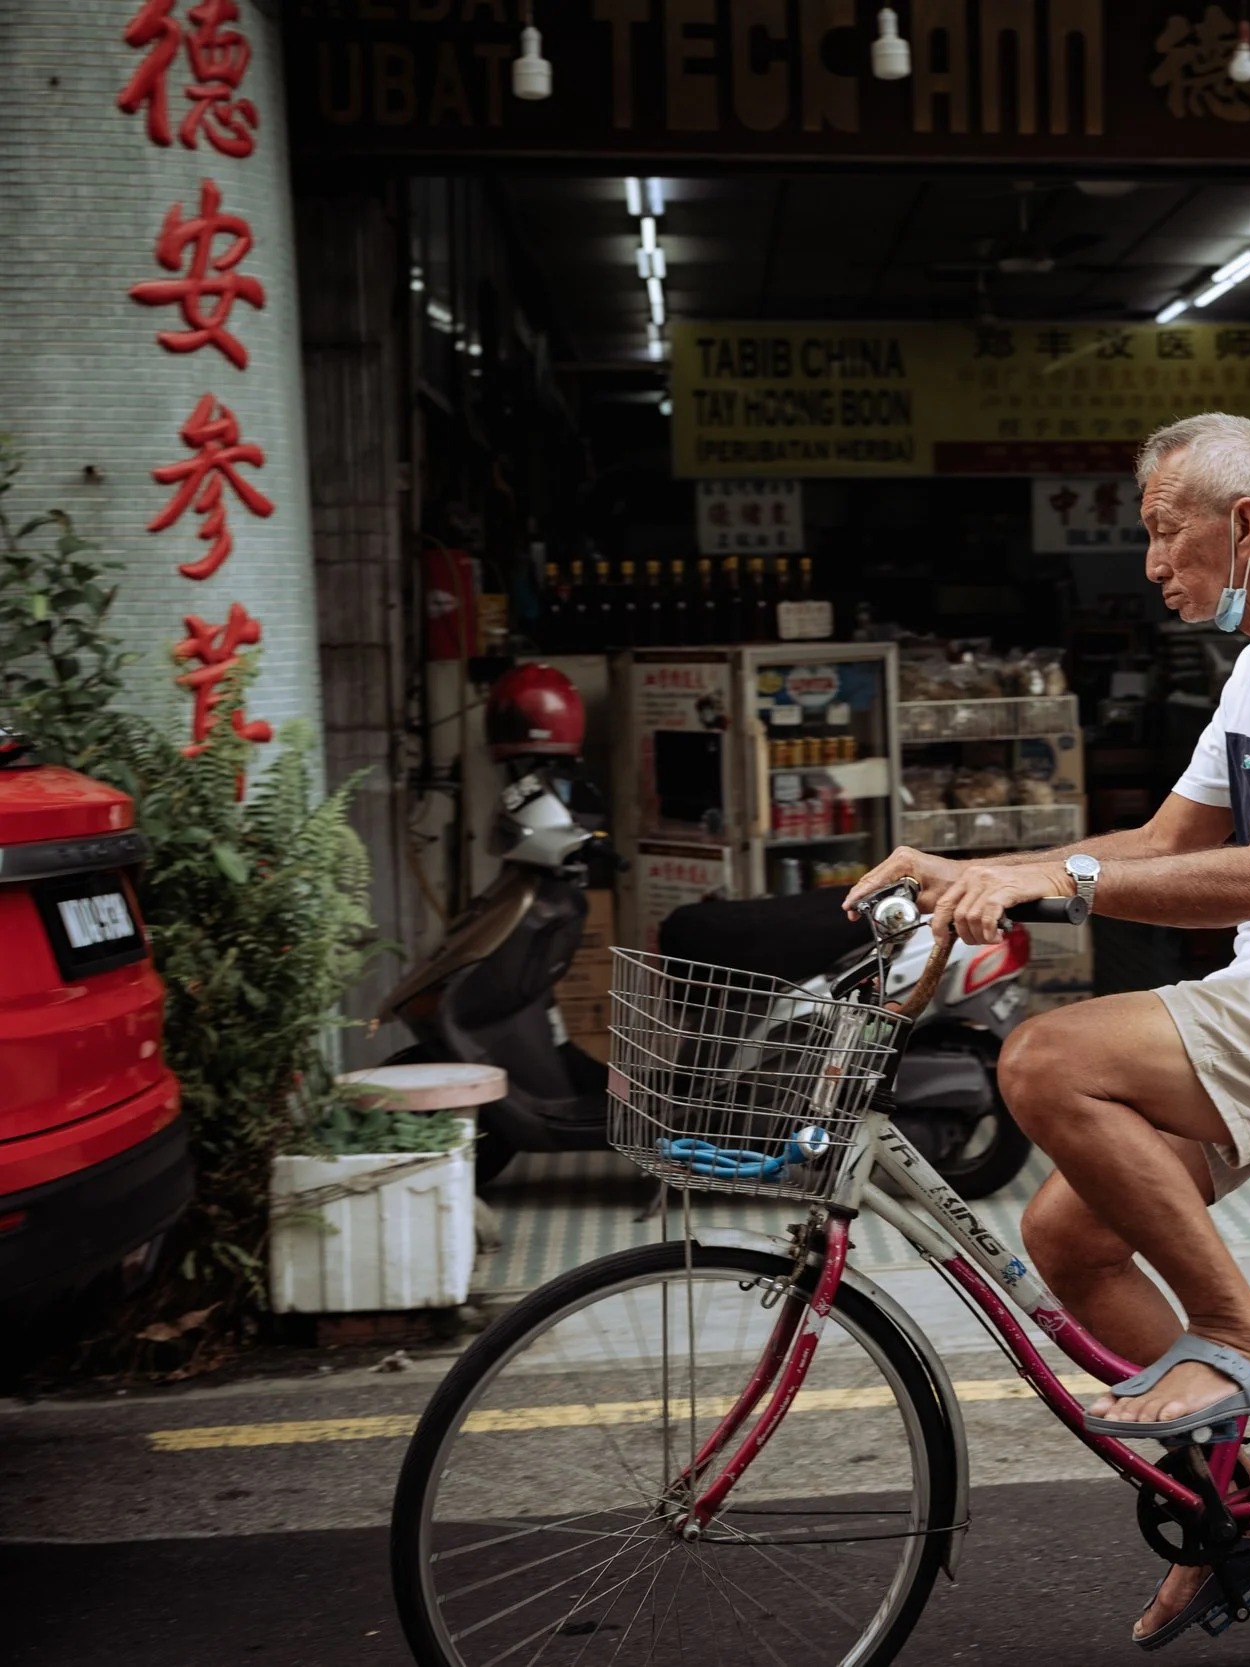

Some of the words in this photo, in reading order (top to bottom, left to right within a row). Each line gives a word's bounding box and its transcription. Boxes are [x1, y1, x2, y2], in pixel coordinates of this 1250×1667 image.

[316, 39, 514, 128] UBAT
[697, 338, 793, 378] TABIB
[800, 338, 907, 378] CHINA
[693, 389, 737, 427] TAY
[743, 388, 834, 427] HOONG
[841, 388, 912, 427] BOON
